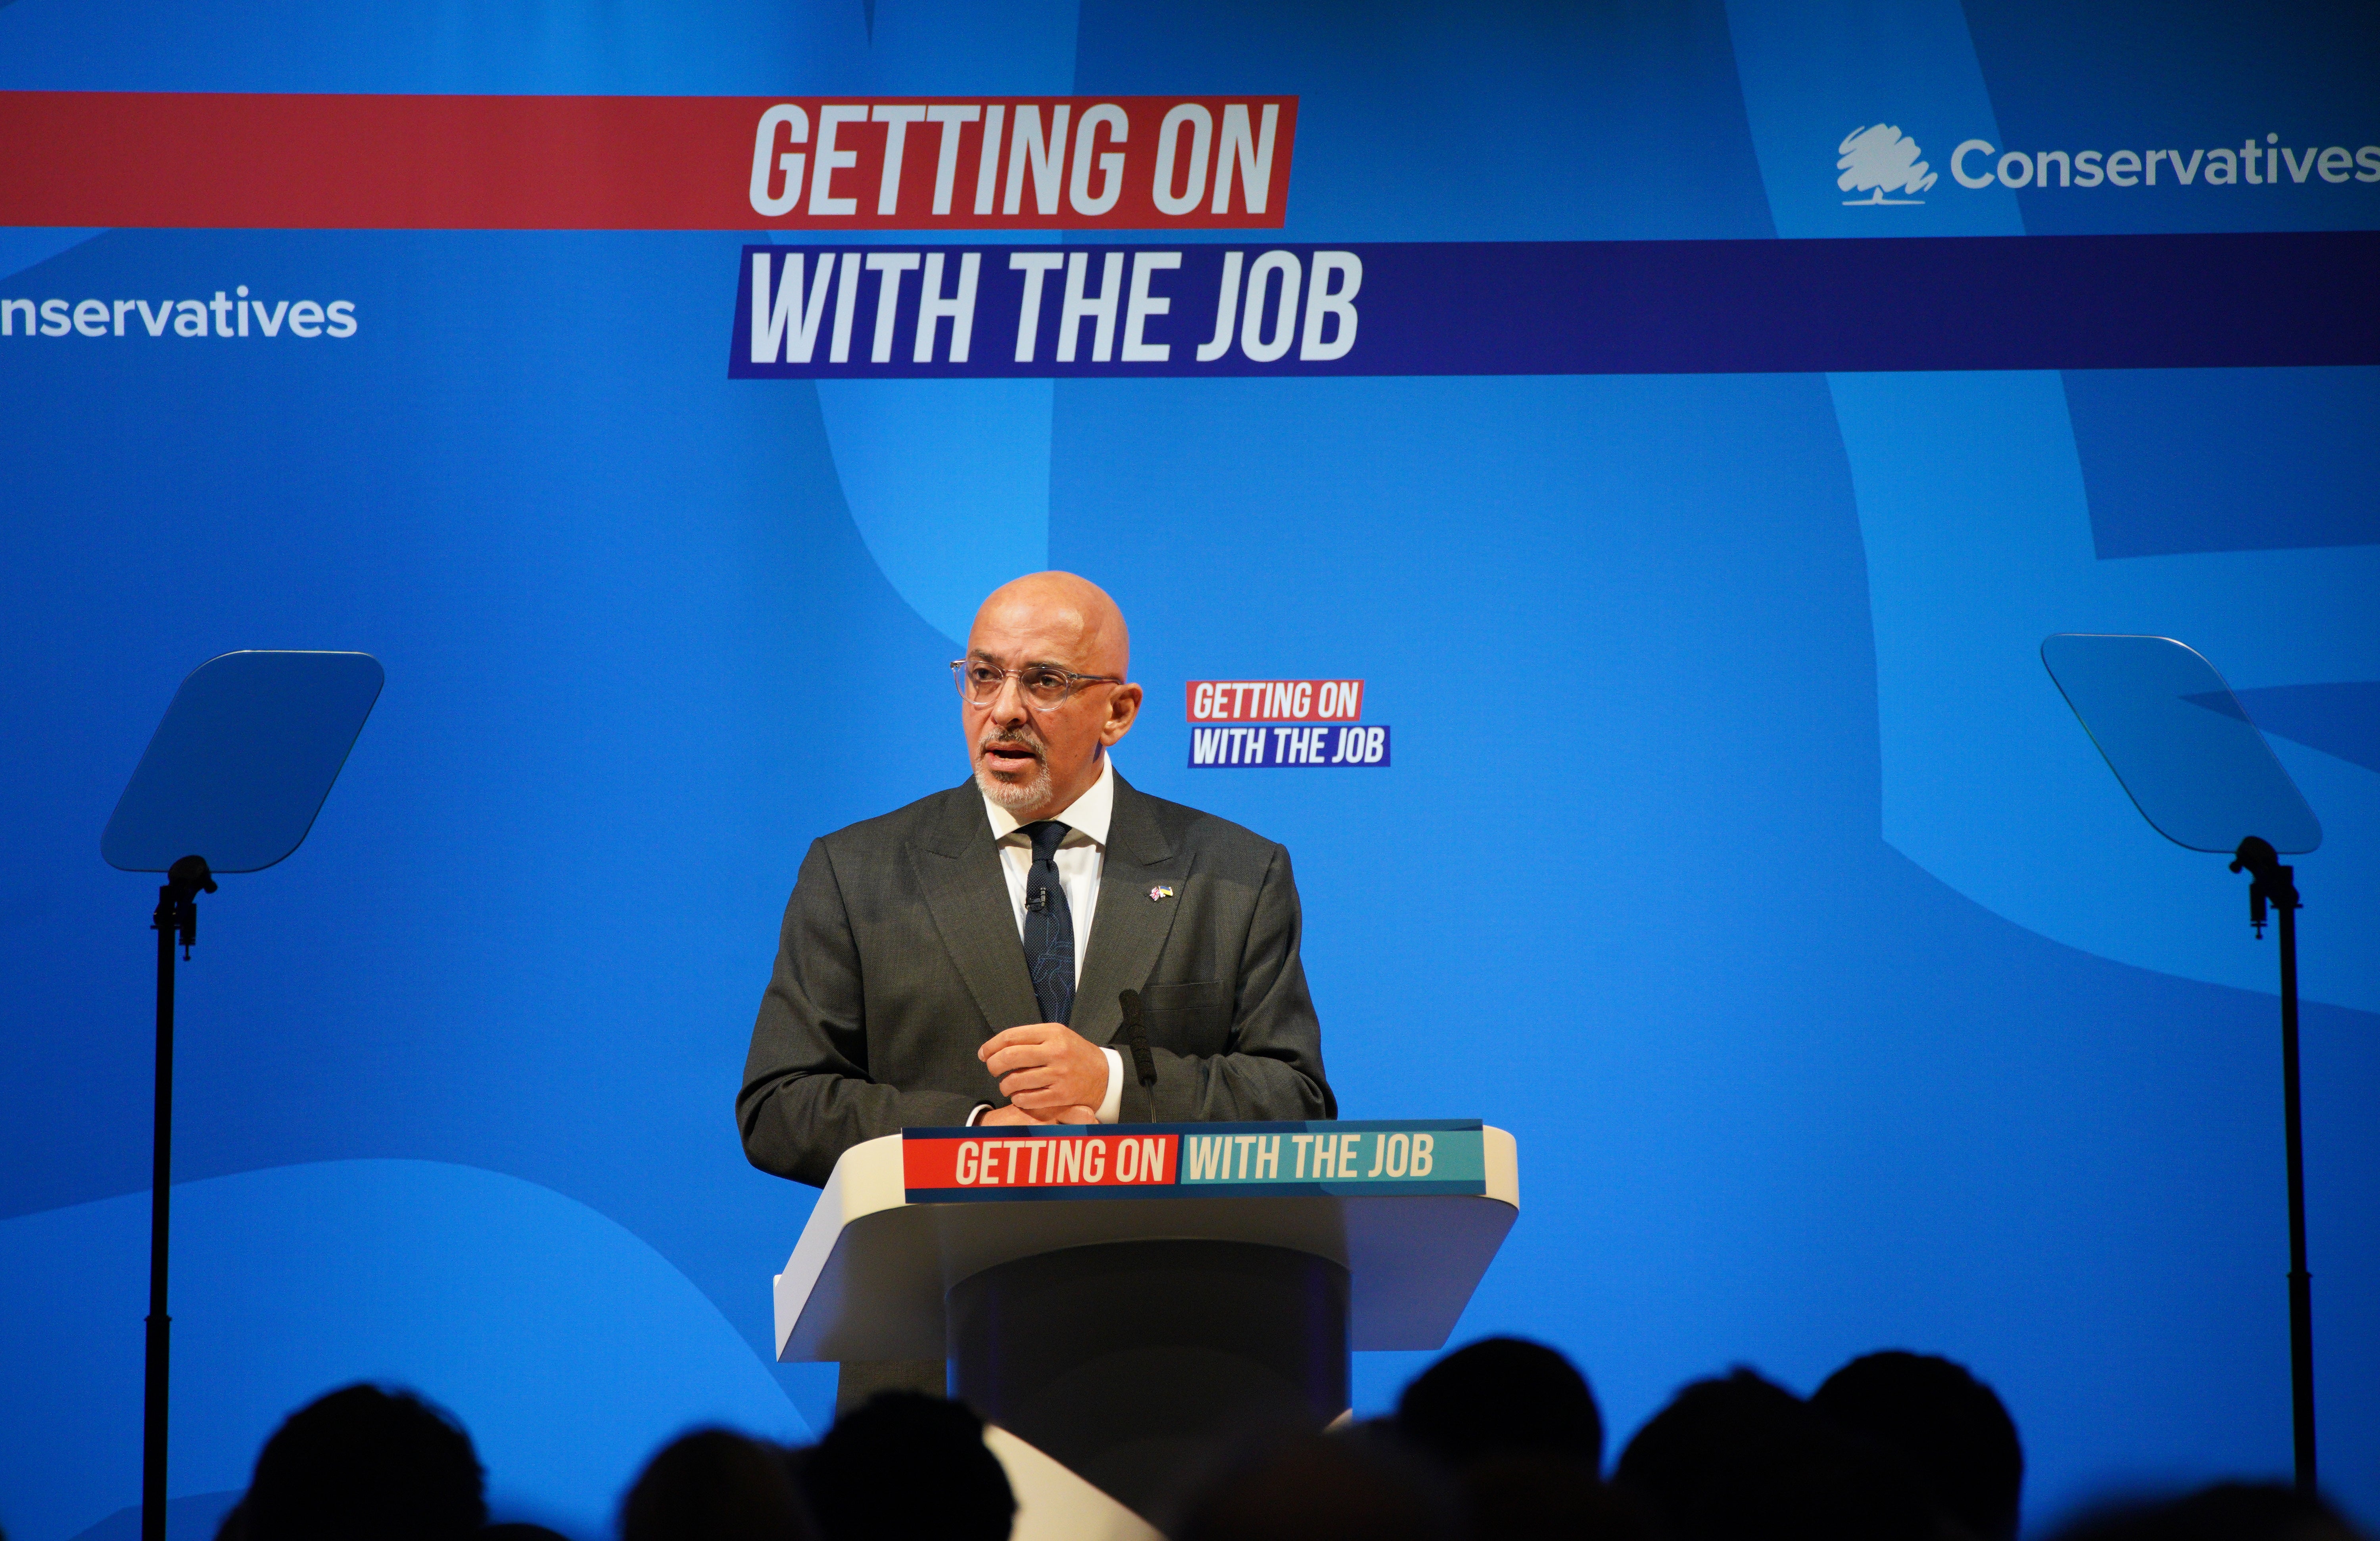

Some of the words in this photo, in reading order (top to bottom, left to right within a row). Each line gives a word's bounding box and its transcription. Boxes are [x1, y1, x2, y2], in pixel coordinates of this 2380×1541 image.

[749, 104, 1129, 217] GETTING
[1152, 104, 1280, 216] ON
[1950, 133, 2380, 189] Conservatives
[1, 285, 358, 338] nservatives
[750, 253, 981, 363] WITH
[1009, 252, 1182, 362] THE
[1196, 250, 1363, 362] JOB
[1193, 682, 1312, 719] GETTING
[1318, 681, 1359, 718] ON
[1194, 728, 1267, 764] WITH
[1273, 727, 1329, 763] THE
[1331, 727, 1386, 763] JOB
[956, 1138, 1106, 1185] GETTING
[1115, 1138, 1166, 1183] ON
[1190, 1135, 1281, 1180] WITH
[1292, 1134, 1361, 1179] THE
[1368, 1133, 1434, 1178] JOB
